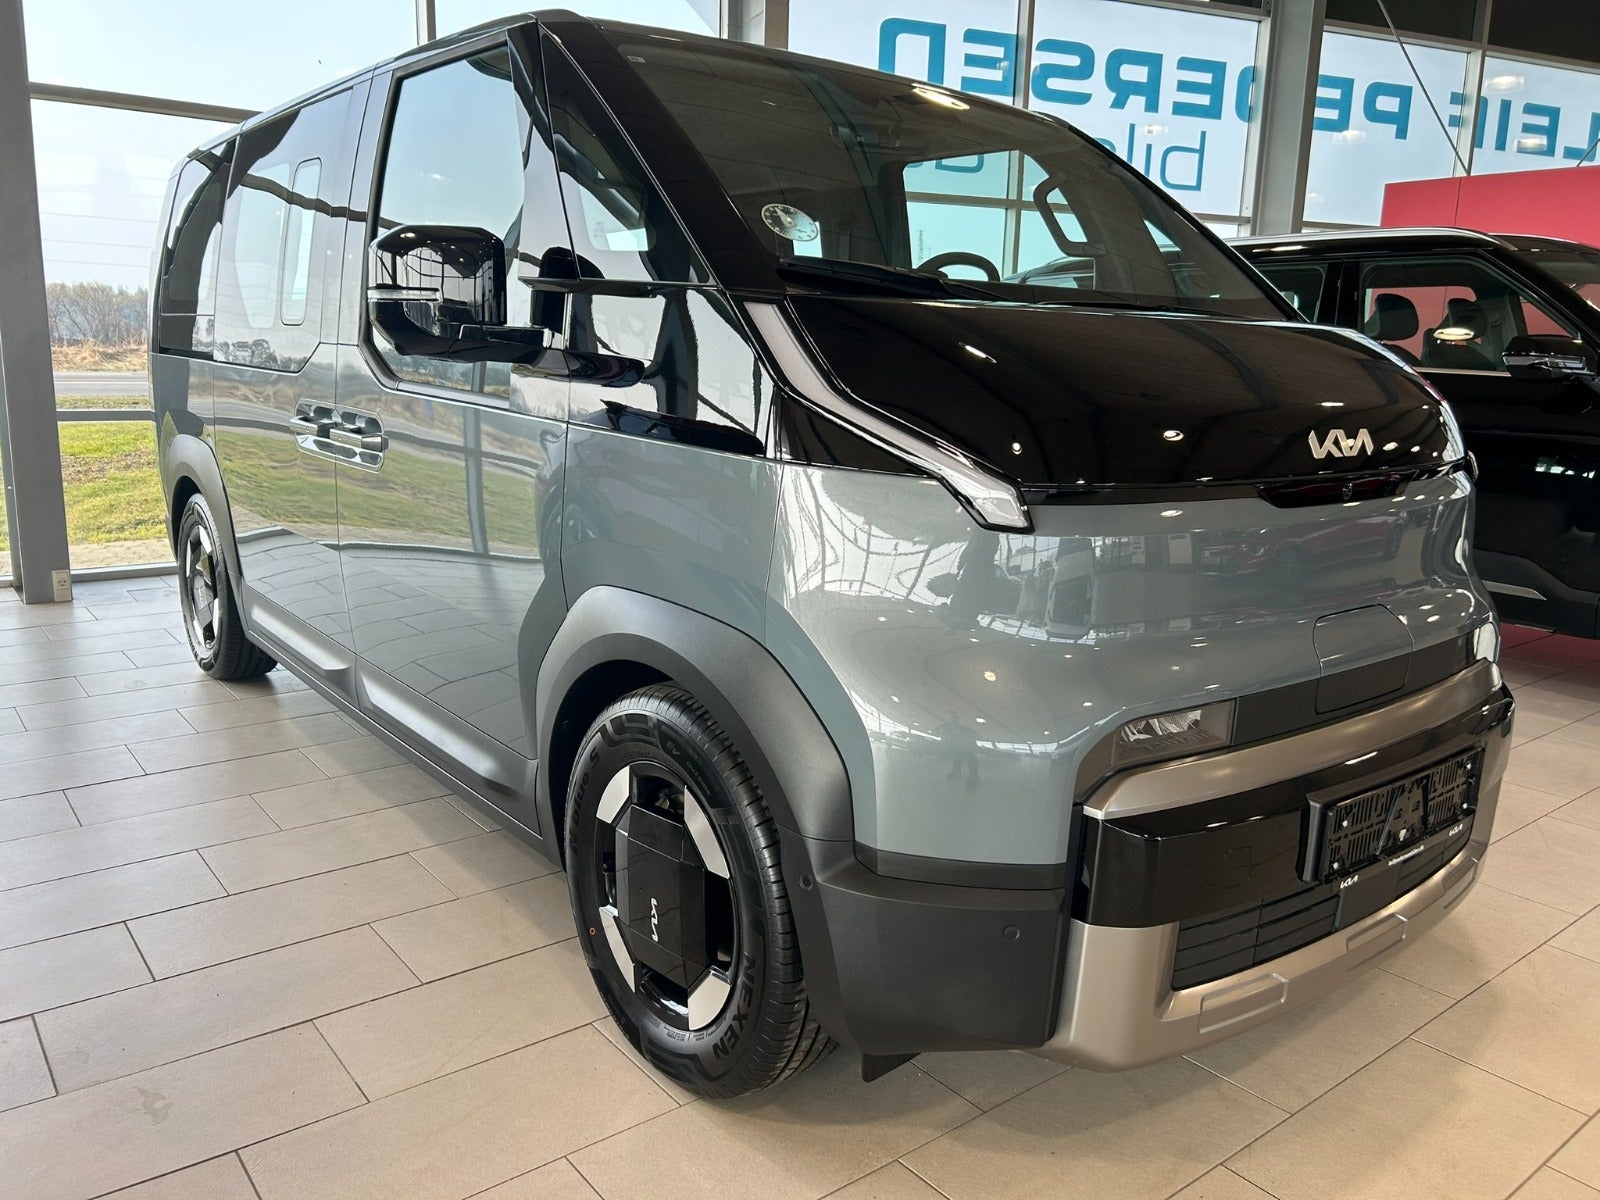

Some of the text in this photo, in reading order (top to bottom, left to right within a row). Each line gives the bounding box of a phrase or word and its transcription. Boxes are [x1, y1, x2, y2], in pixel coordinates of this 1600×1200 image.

[1308, 428, 1374, 459] KIA
[651, 897, 659, 942] KIA
[712, 952, 756, 1062] NEXEN
